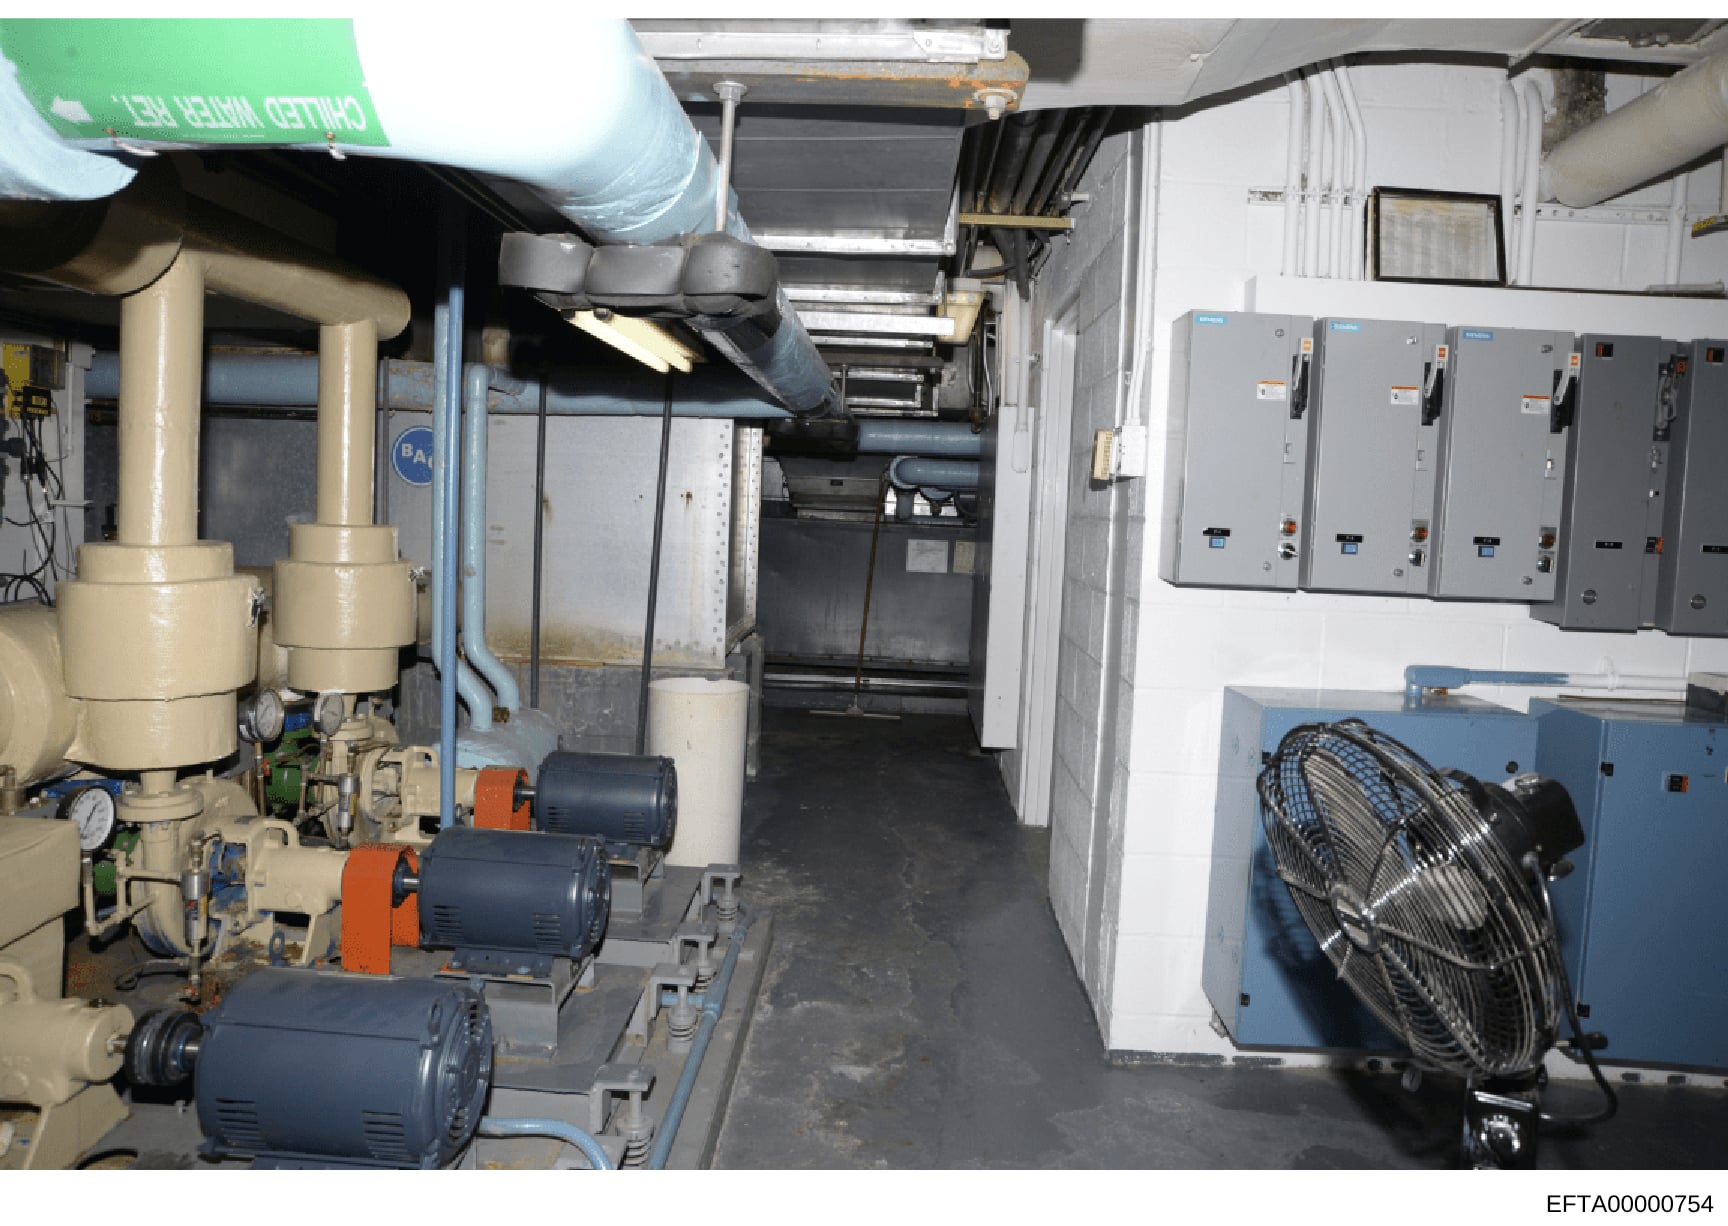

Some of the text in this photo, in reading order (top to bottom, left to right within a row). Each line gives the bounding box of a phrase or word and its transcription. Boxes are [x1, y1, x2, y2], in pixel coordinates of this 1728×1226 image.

[110, 95, 367, 131] CHILLED WATER RET.
